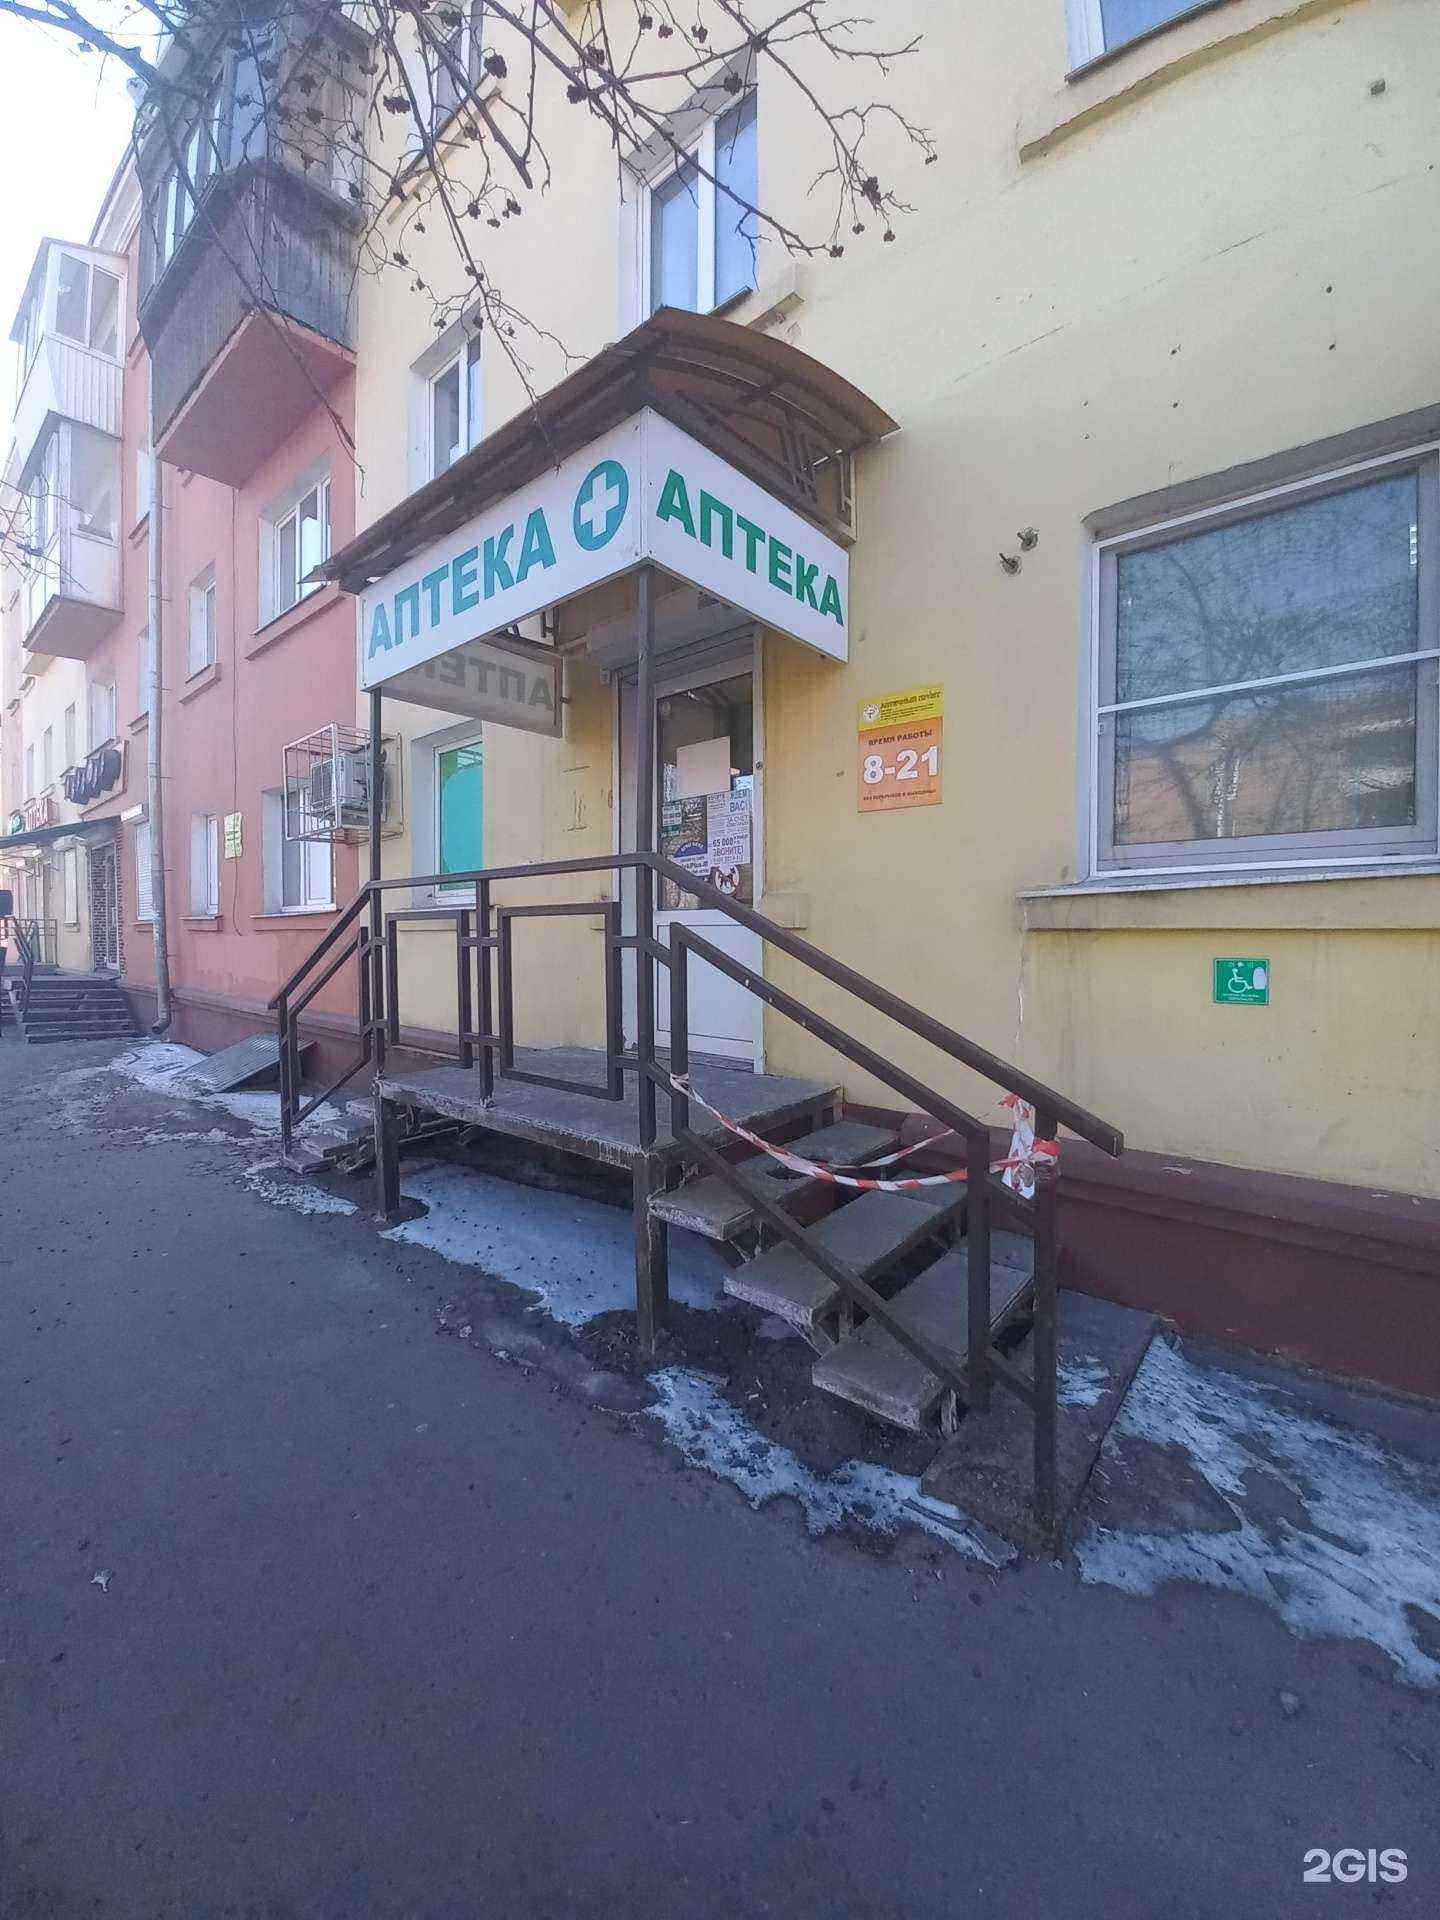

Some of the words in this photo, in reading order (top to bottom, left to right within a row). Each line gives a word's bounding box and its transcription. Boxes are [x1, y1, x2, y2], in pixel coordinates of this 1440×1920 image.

[368, 507, 557, 660] АПТЕКА
[656, 468, 844, 626] АПТЕКА
[863, 745, 939, 784] 8-21
[868, 736, 895, 746] ВРЕМЯ
[897, 729, 933, 743] РАБОТЫ
